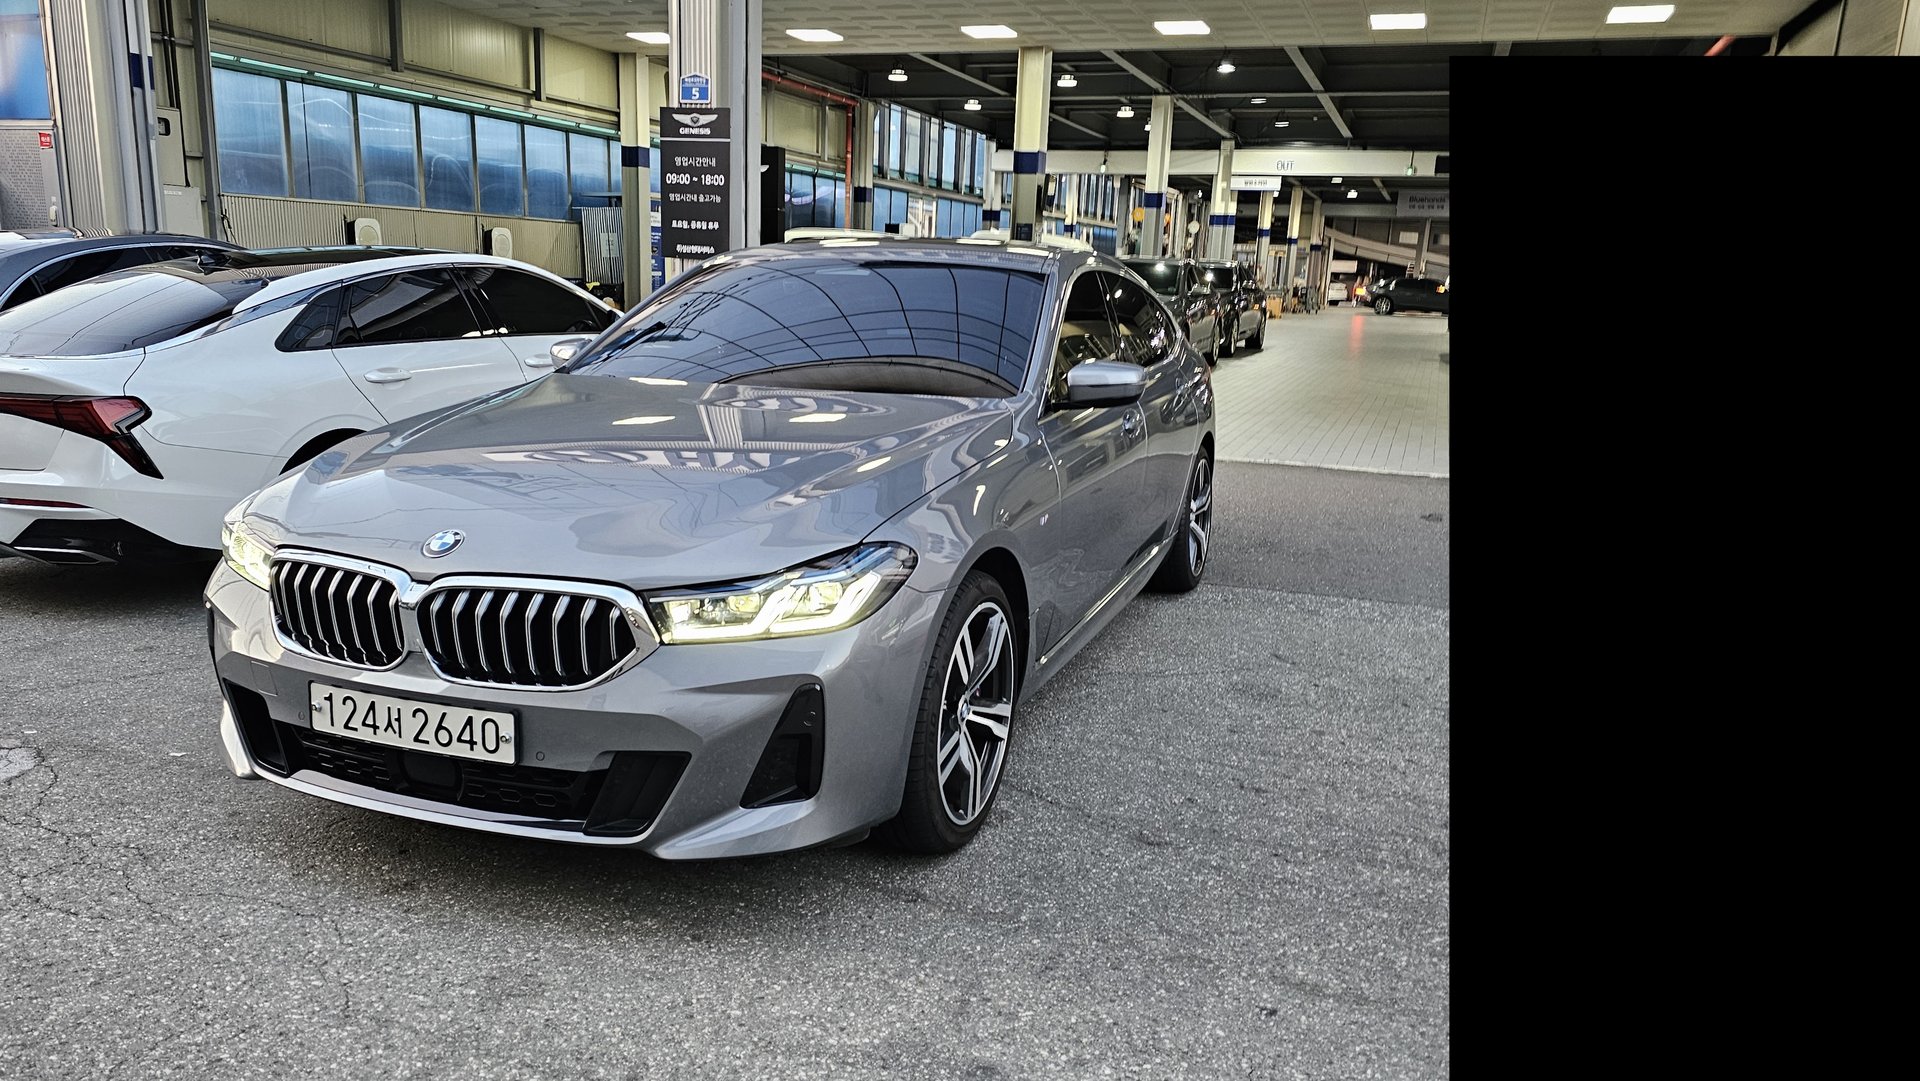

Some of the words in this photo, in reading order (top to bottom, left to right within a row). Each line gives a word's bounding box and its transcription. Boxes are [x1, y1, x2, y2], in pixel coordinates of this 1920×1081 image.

[691, 87, 700, 99] 5
[679, 127, 711, 135] GENESIS
[675, 156, 716, 167] 영업시간안내
[1276, 160, 1295, 171] OUT
[666, 173, 691, 185] 09:00
[701, 174, 725, 186] 18:00
[323, 692, 403, 739] 124서
[411, 707, 501, 755] 2640
